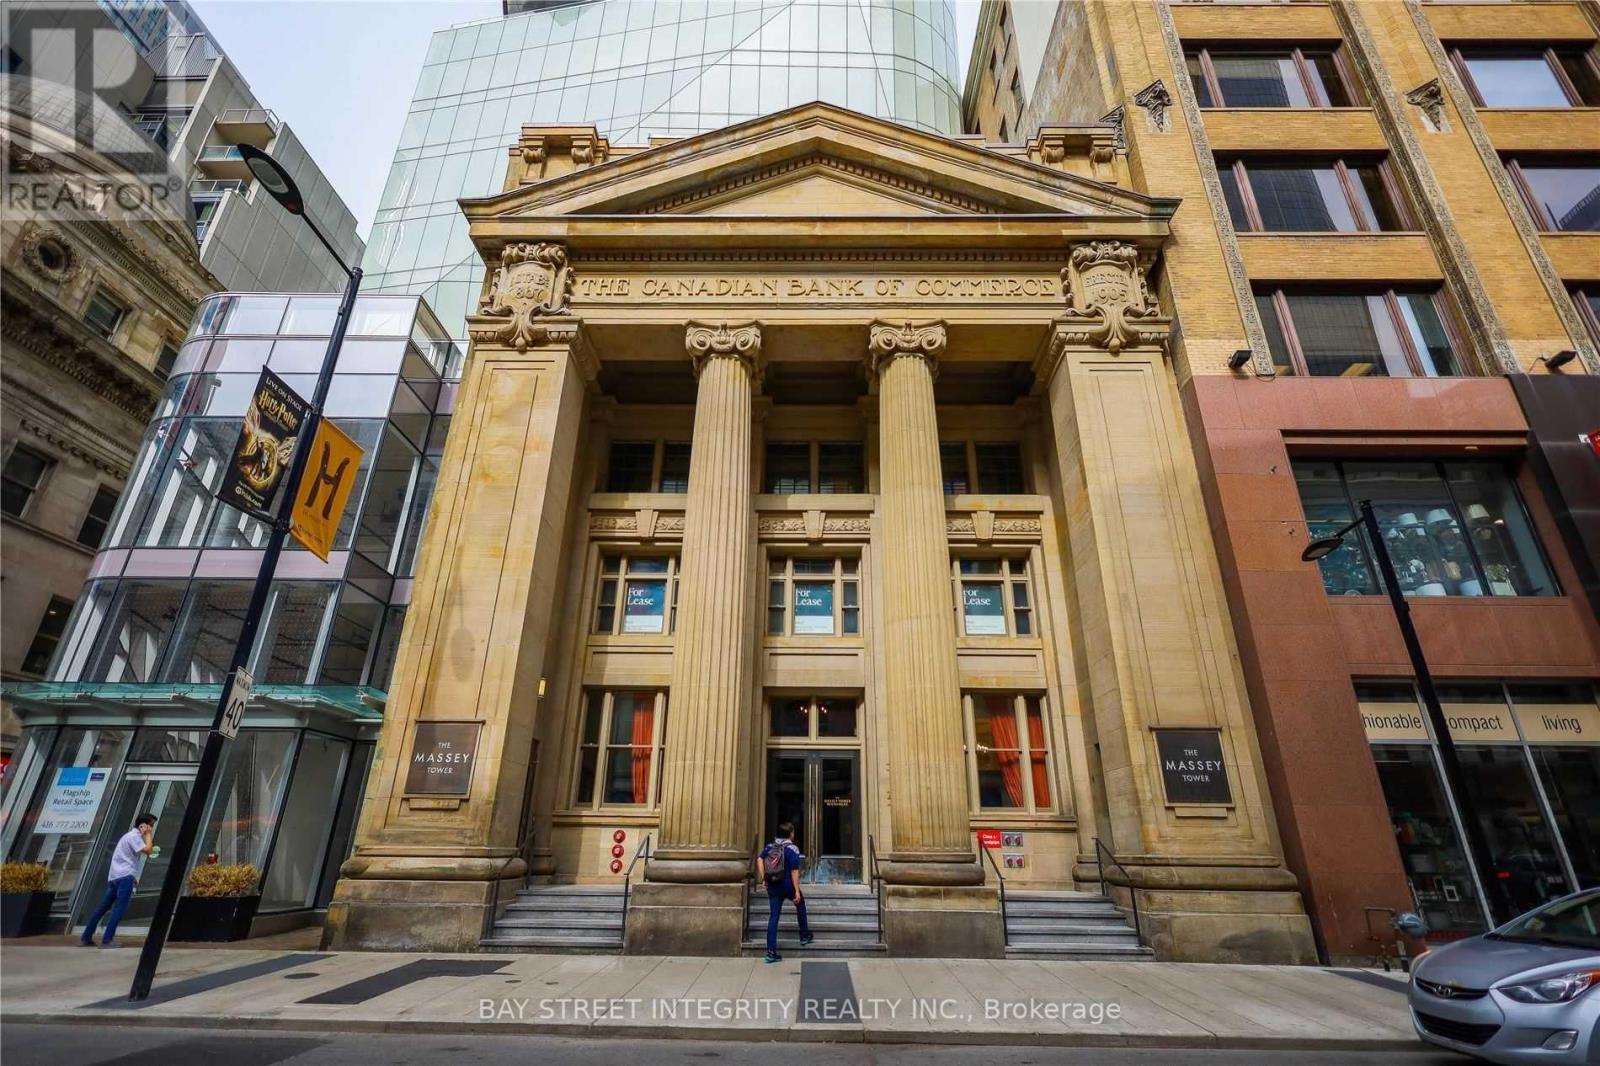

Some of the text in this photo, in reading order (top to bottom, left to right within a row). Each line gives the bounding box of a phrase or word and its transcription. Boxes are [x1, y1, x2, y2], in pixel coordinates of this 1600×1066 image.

[581, 279, 1056, 296] THE CANADIAN BANK OF COMMERCE
[258, 390, 280, 414] Harry
[304, 441, 351, 520] H
[628, 587, 644, 597] For
[627, 596, 654, 606] Lease
[796, 596, 823, 606] Lease
[226, 697, 244, 729] 40
[1541, 715, 1582, 734] living
[414, 753, 470, 763] MASSEY
[1184, 749, 1199, 757] THE
[1166, 760, 1221, 771] MASSEY
[1182, 774, 1210, 782] TOWER
[62, 788, 91, 798] Flagship
[52, 798, 94, 807] Retail Space
